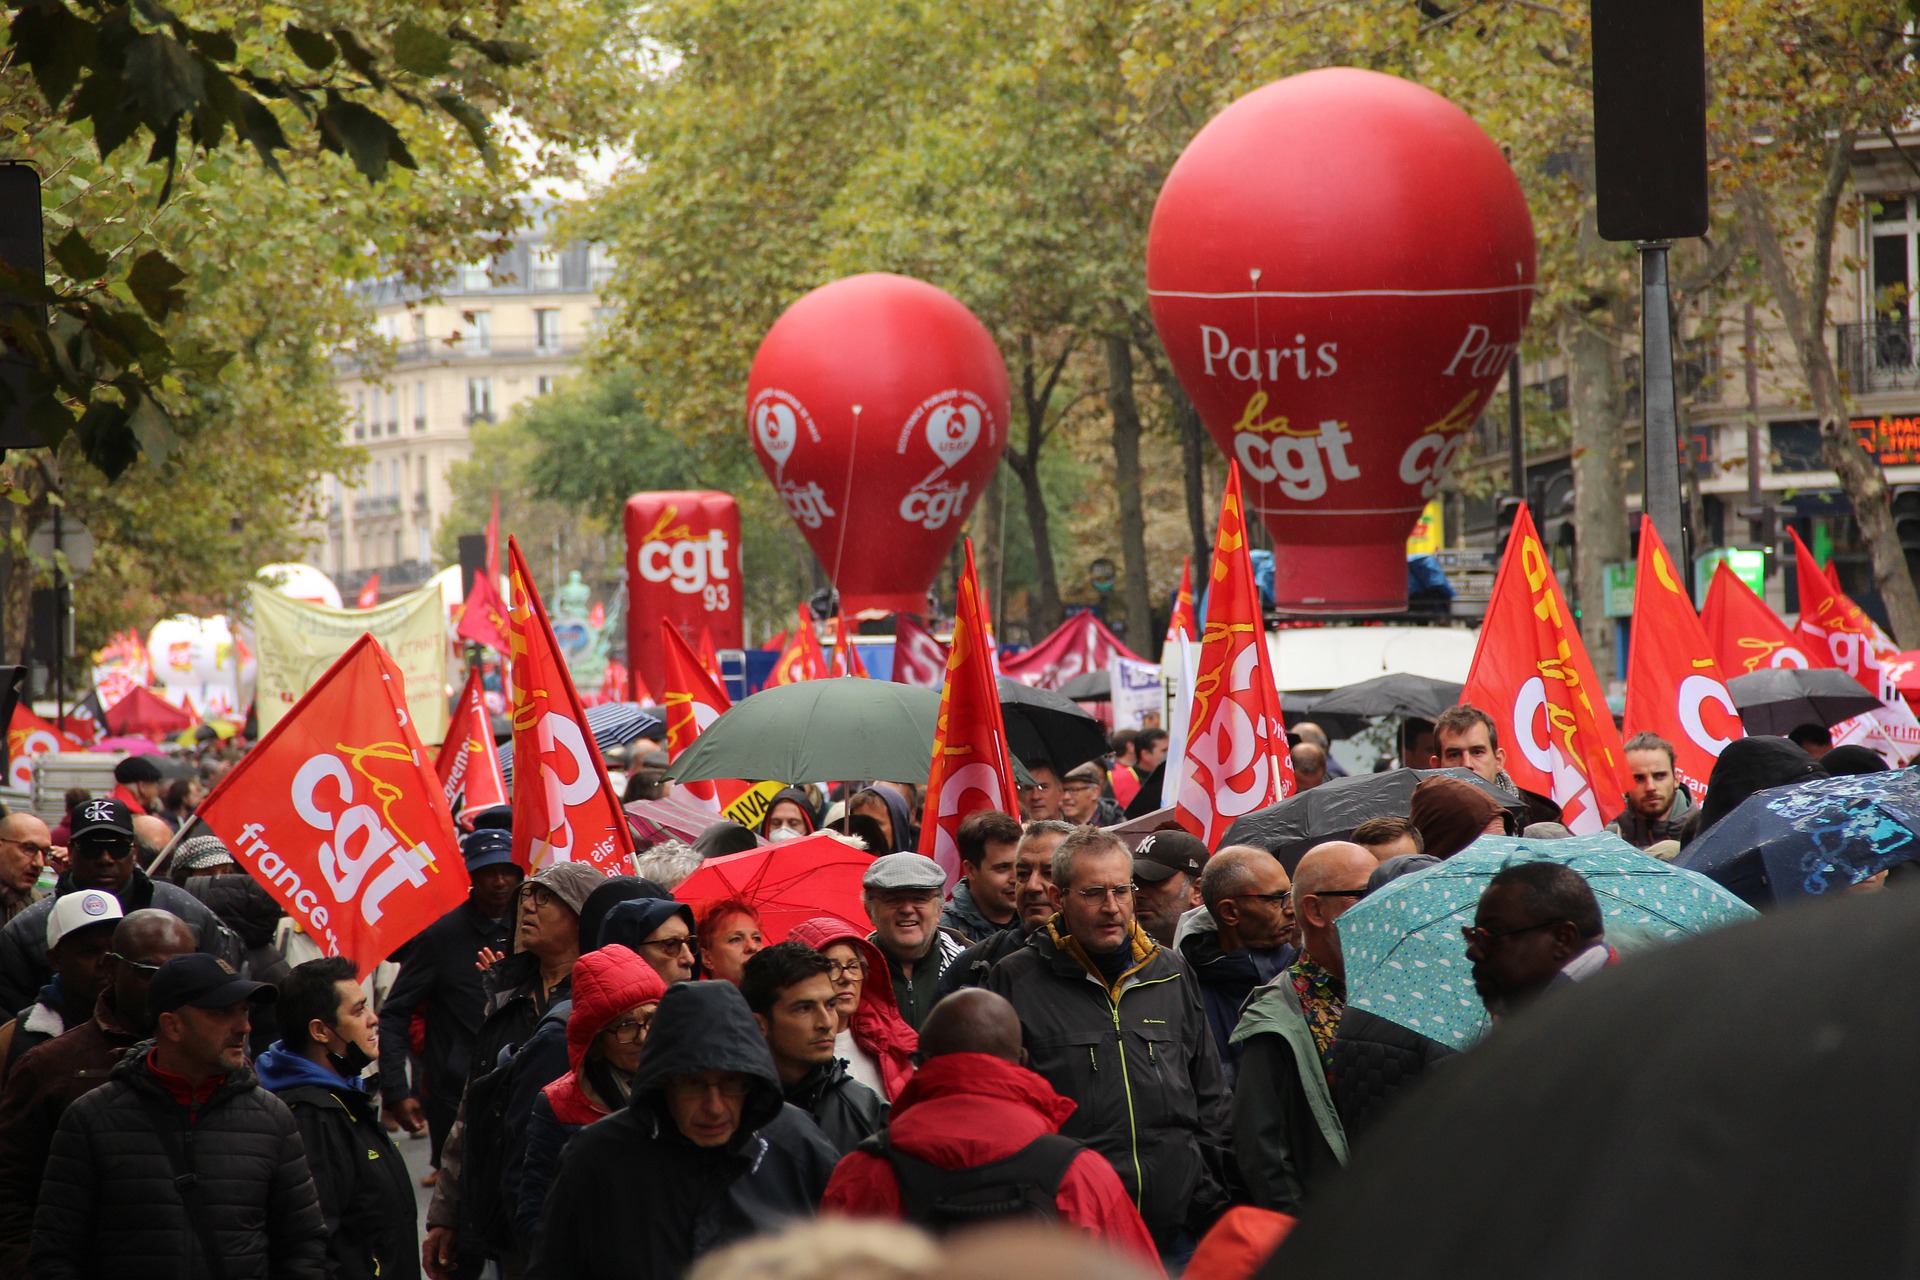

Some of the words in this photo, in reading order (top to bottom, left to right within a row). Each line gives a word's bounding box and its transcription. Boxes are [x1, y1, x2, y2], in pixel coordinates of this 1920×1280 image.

[1200, 324, 1338, 381] Paris
[1233, 390, 1348, 437] la
[1234, 420, 1360, 501] cgt
[1399, 434, 1465, 499] cg
[899, 481, 969, 530] cgt
[638, 529, 729, 594] cgt
[703, 584, 730, 612] 93
[336, 741, 440, 874] la
[291, 753, 436, 926] cgt
[1135, 835, 1157, 854] NY
